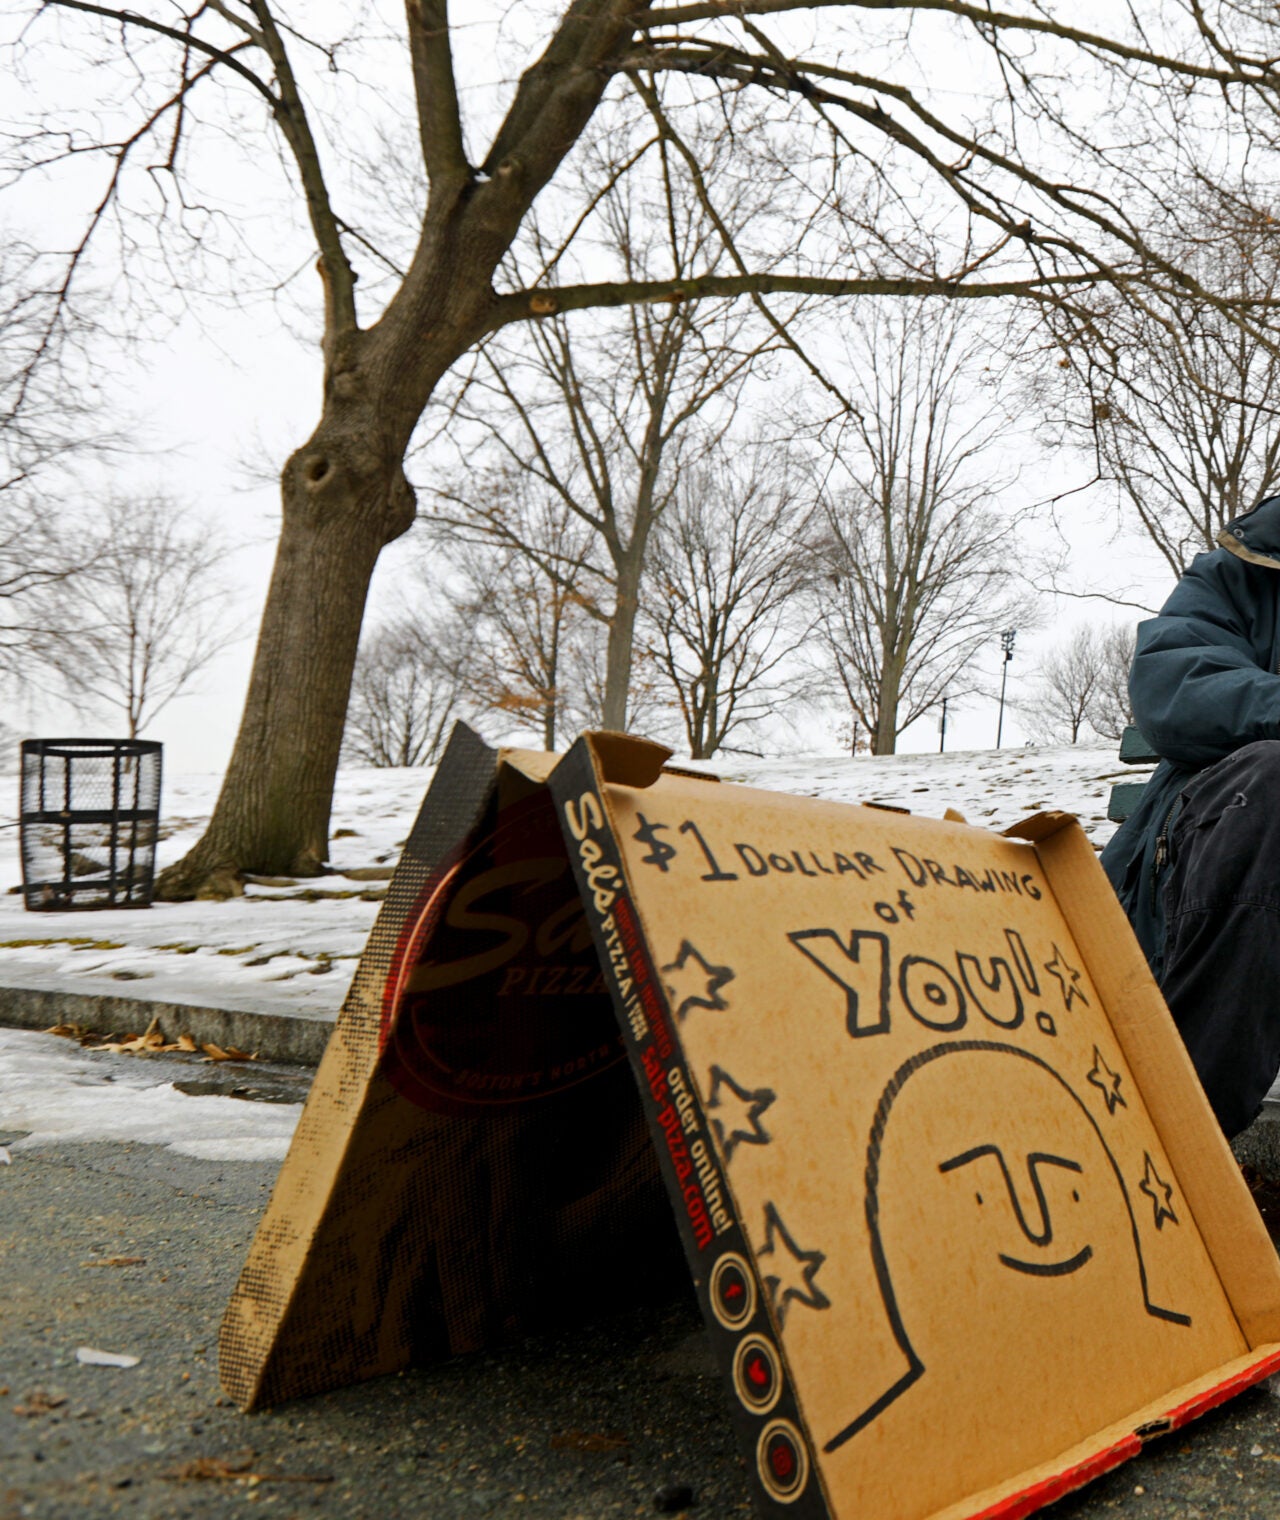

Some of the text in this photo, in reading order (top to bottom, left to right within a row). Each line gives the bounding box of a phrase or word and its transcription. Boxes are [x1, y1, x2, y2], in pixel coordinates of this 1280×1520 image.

[564, 791, 623, 915] Sal's
[632, 811, 738, 881] $1
[601, 913, 633, 999] PIZZA
[641, 1046, 713, 1251] sals-pizza.com
[667, 1066, 734, 1236] order online!
